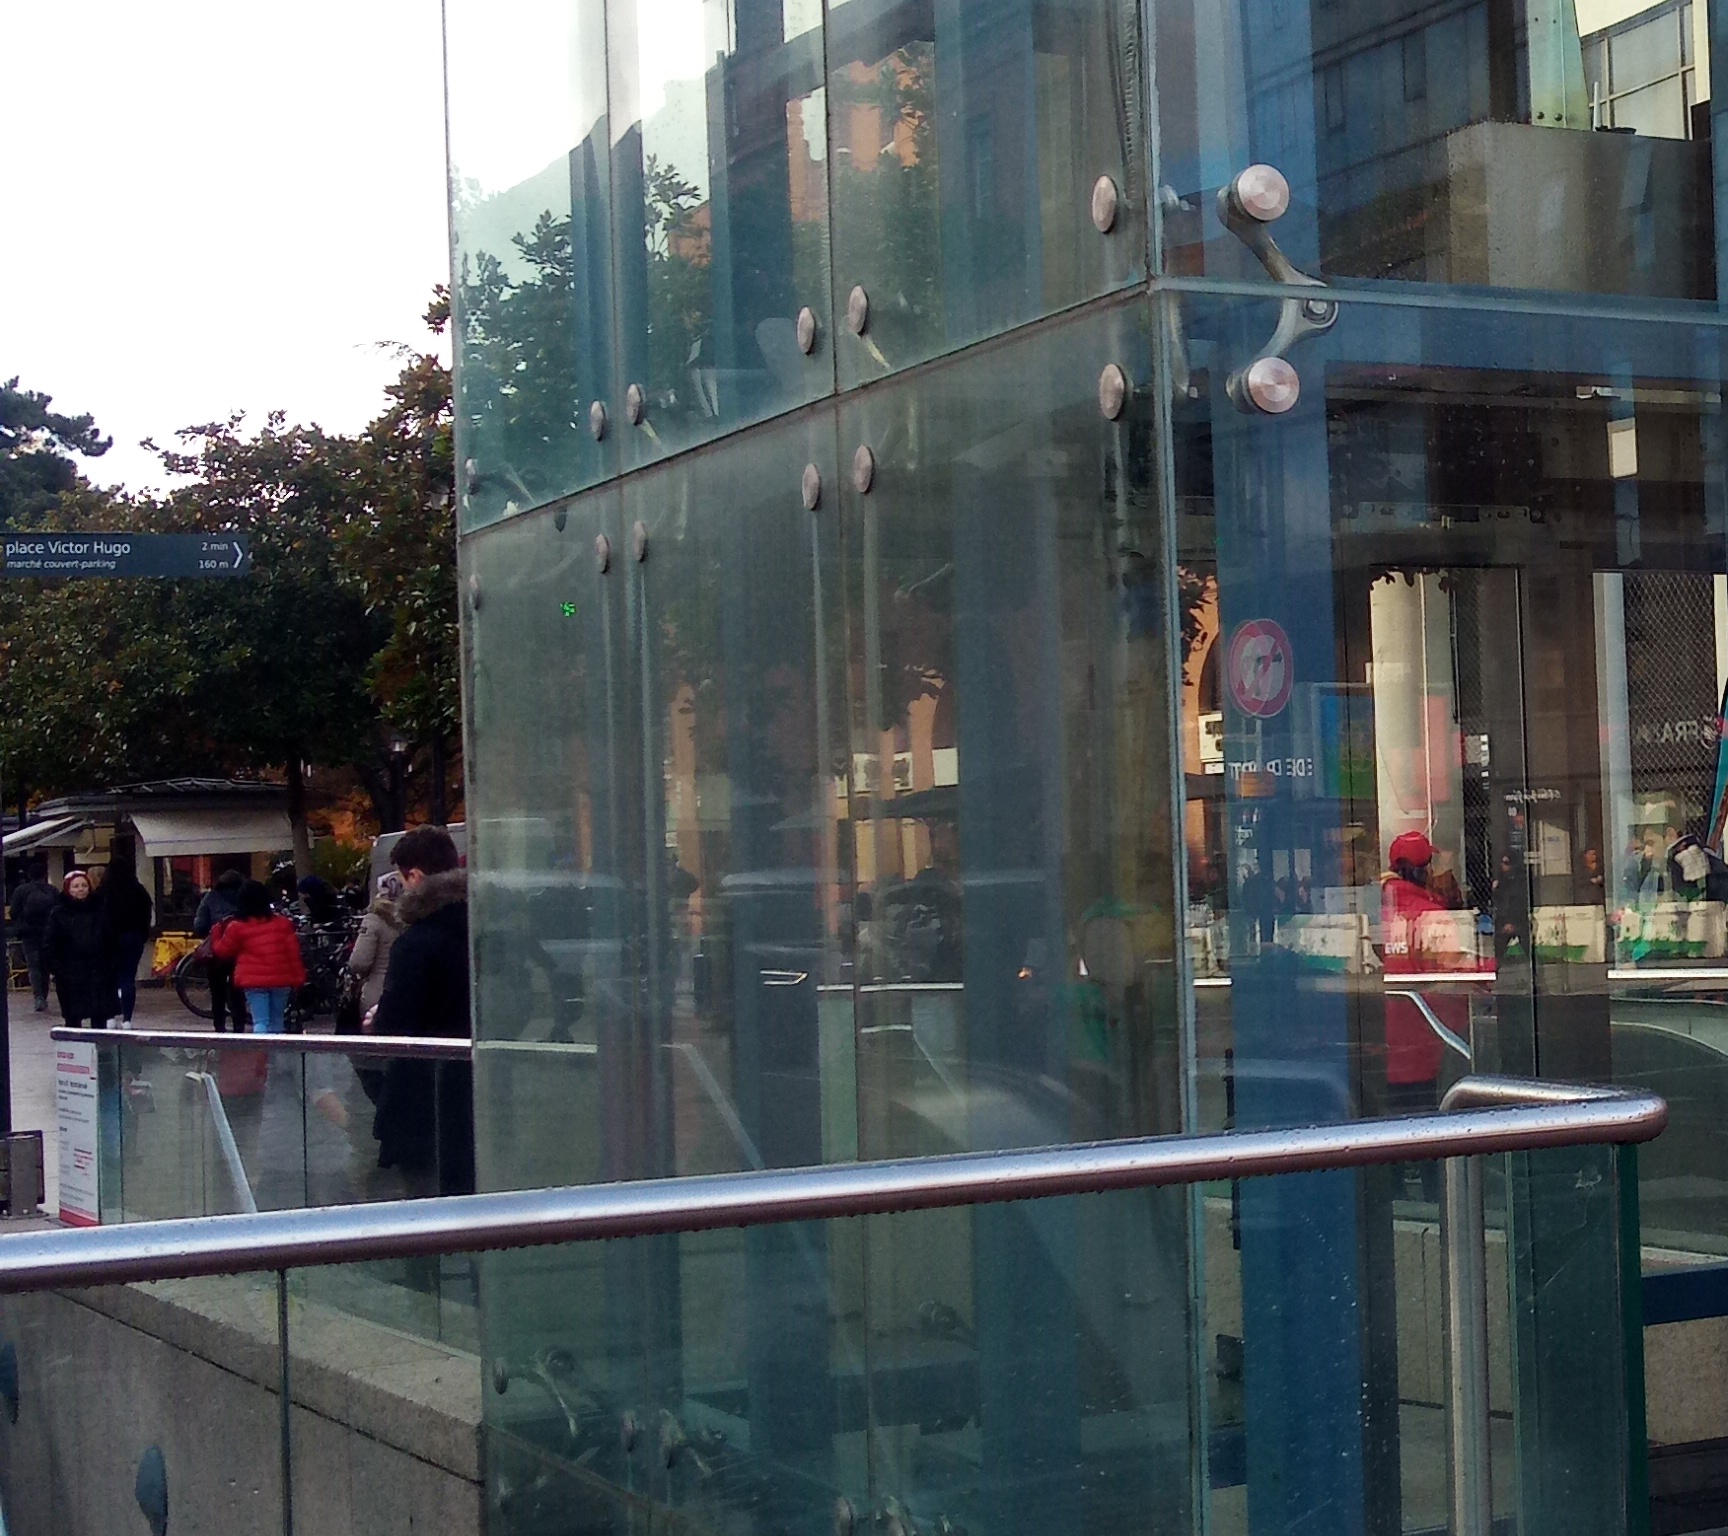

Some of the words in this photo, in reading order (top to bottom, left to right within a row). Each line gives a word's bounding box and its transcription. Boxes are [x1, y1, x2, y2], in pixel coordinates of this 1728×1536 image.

[6, 541, 44, 556] place
[49, 541, 90, 554] Victor
[93, 541, 131, 556] Hugo
[201, 542, 208, 551] 2
[210, 542, 229, 551] min
[6, 558, 41, 569] marché
[198, 560, 217, 569] 160
[219, 561, 229, 569] m
